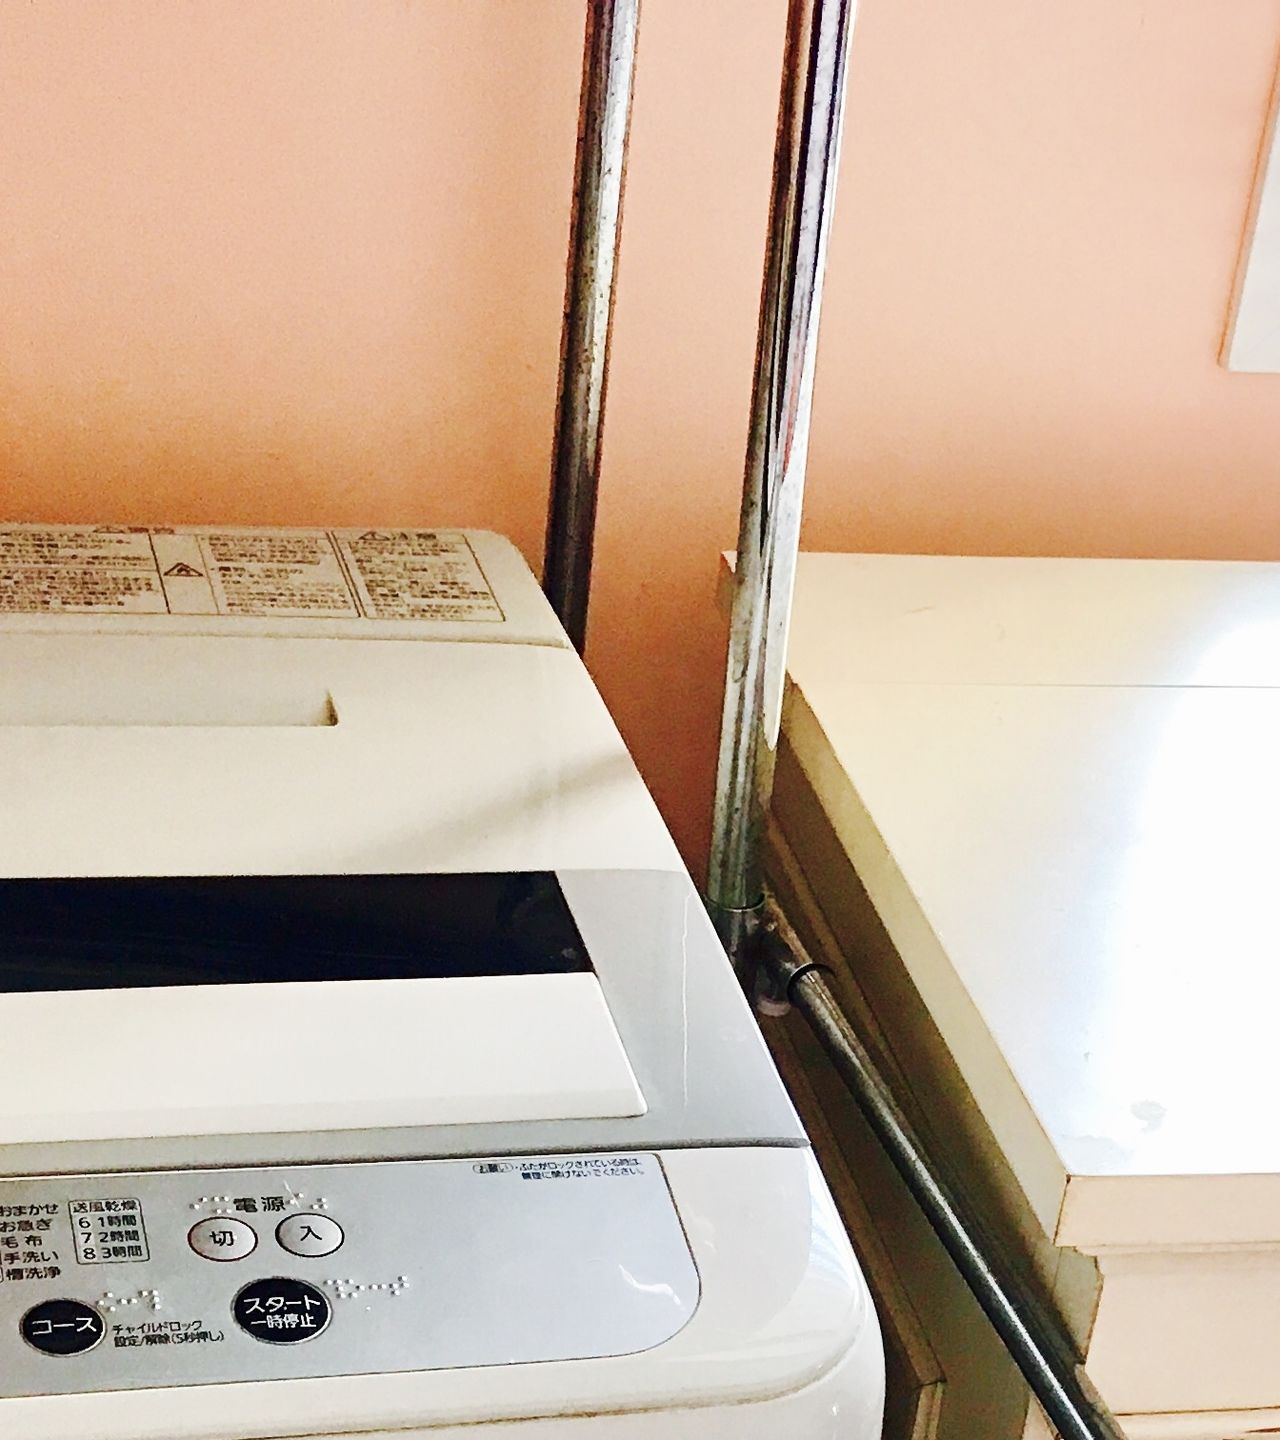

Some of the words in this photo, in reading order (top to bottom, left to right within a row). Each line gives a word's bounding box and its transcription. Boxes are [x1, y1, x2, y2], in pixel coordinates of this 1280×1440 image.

[72, 1200, 138, 1213] 送風乾燥
[232, 1195, 287, 1213] 電源
[77, 1216, 91, 1229] 6
[98, 1215, 137, 1228] 1時間
[80, 1232, 93, 1244] 7
[99, 1230, 141, 1243] 2時間
[209, 1230, 235, 1247] 切
[300, 1225, 323, 1242] 入
[0, 1235, 43, 1248] 毛布
[4, 1250, 58, 1264] 手洗い
[83, 1247, 96, 1260] 8
[102, 1246, 143, 1259] 3時間
[6, 1266, 61, 1281] 槽洗浄
[243, 1294, 321, 1315] スタート
[31, 1316, 98, 1336] コース
[111, 1319, 203, 1334] チャイルドロック
[250, 1313, 317, 1330] 一時停止
